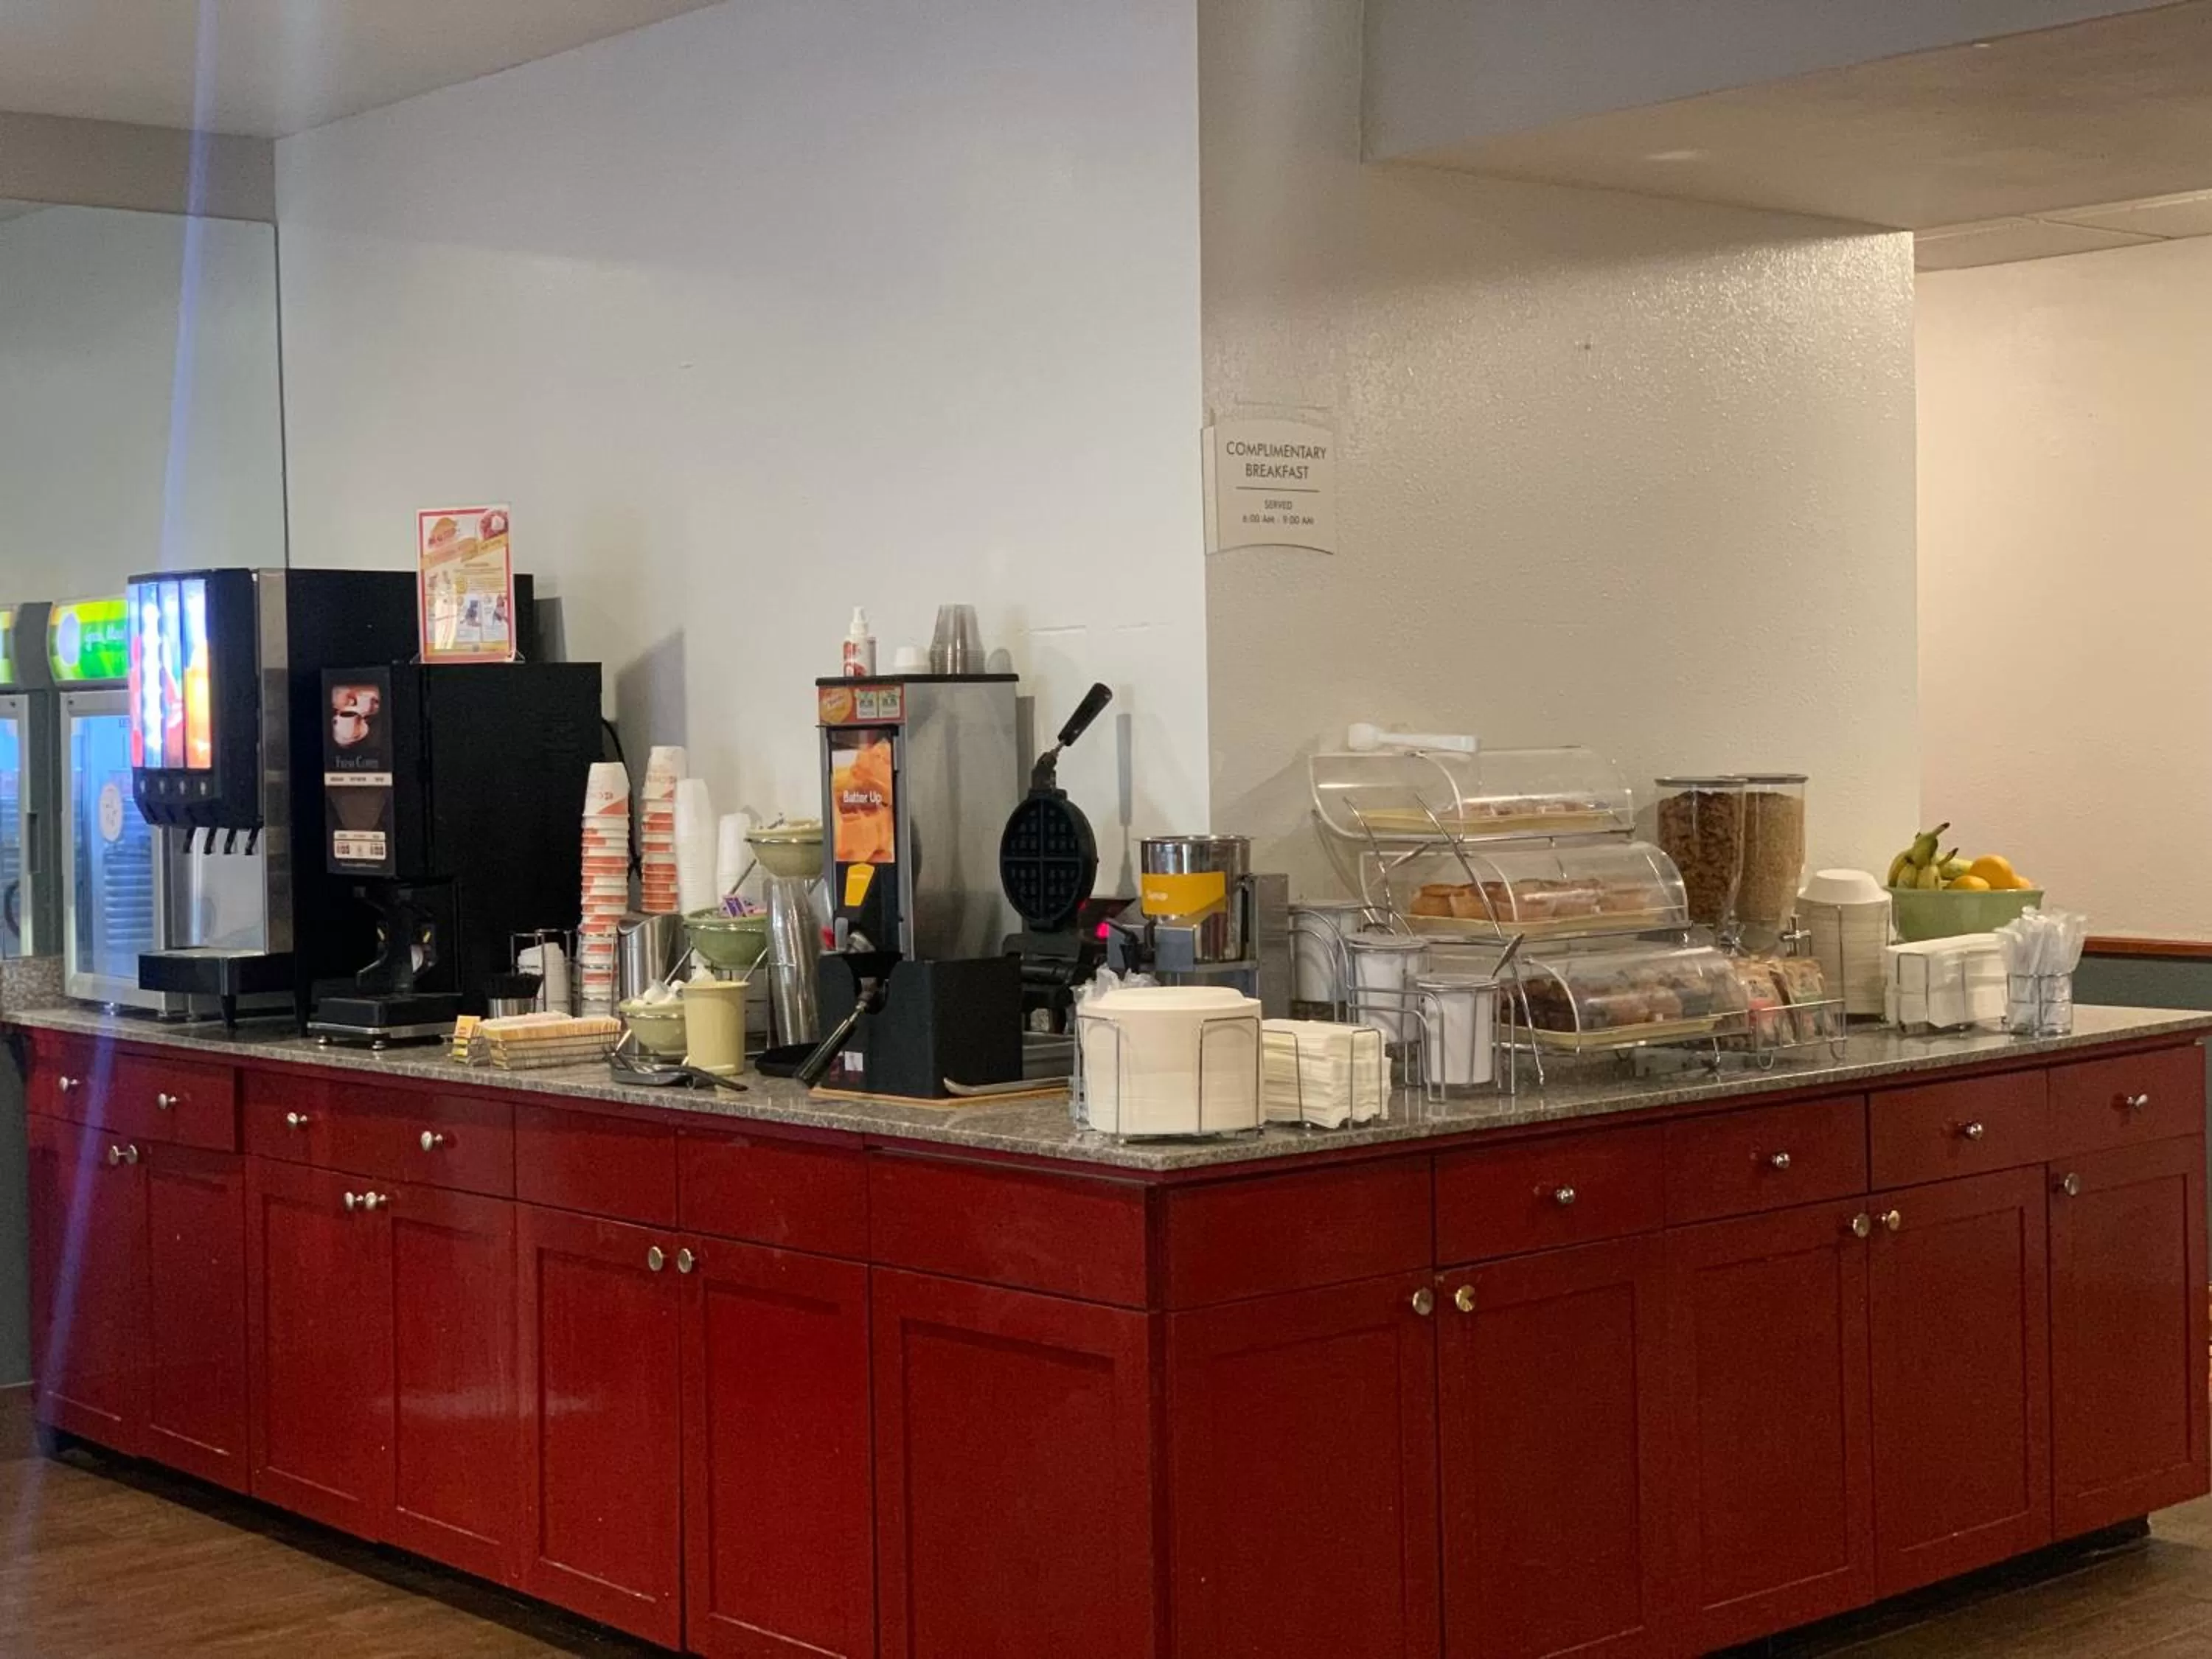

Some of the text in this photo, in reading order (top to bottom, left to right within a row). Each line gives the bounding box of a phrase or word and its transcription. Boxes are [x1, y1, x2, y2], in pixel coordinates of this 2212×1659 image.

[1226, 441, 1326, 459] COMPLIMENTARY
[1245, 463, 1309, 479] BREAKFAST
[1265, 499, 1293, 510] SERVED
[870, 790, 883, 805] Up
